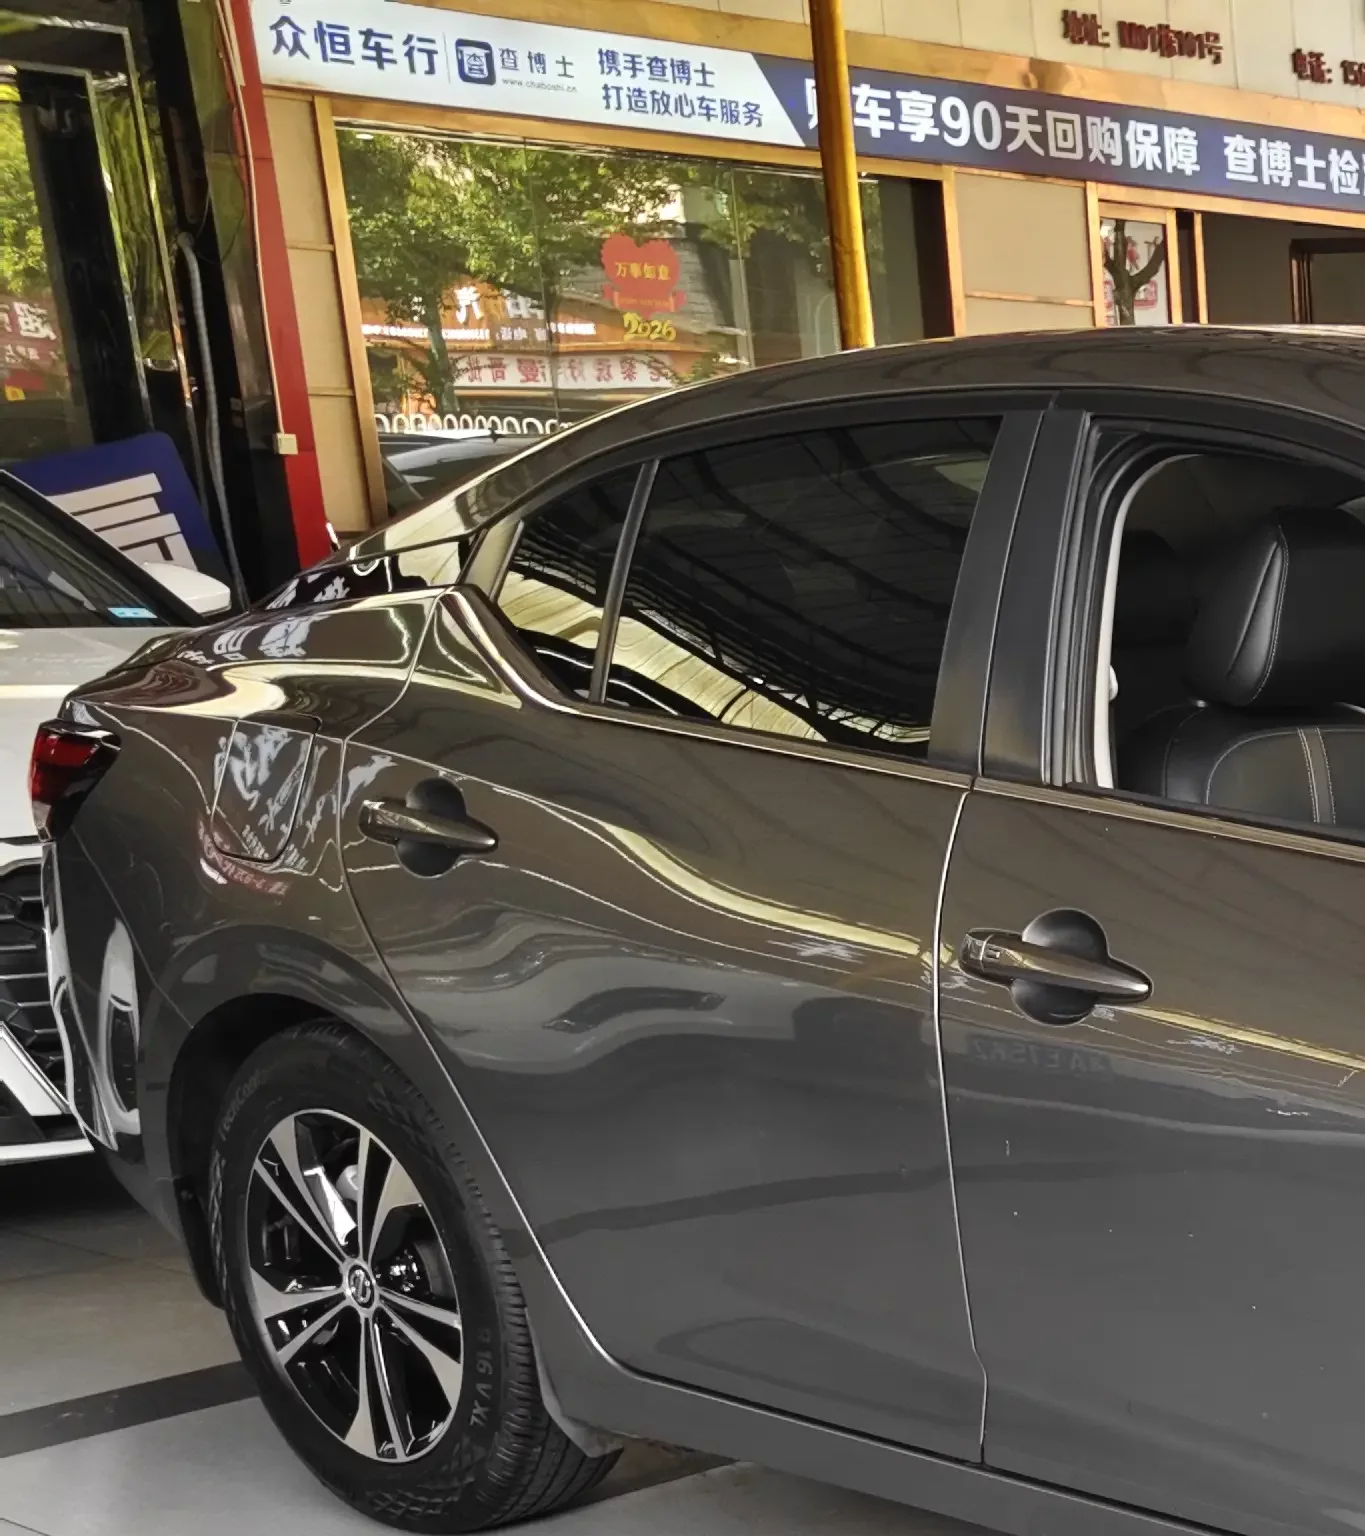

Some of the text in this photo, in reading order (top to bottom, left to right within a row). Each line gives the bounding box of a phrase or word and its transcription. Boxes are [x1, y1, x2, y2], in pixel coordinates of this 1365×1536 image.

[269, 15, 438, 76] 众恒车行
[499, 47, 575, 78] 查博士
[598, 48, 716, 89] 携手查博士
[602, 83, 763, 127] 打造放心车服务
[622, 311, 677, 342] 2026
